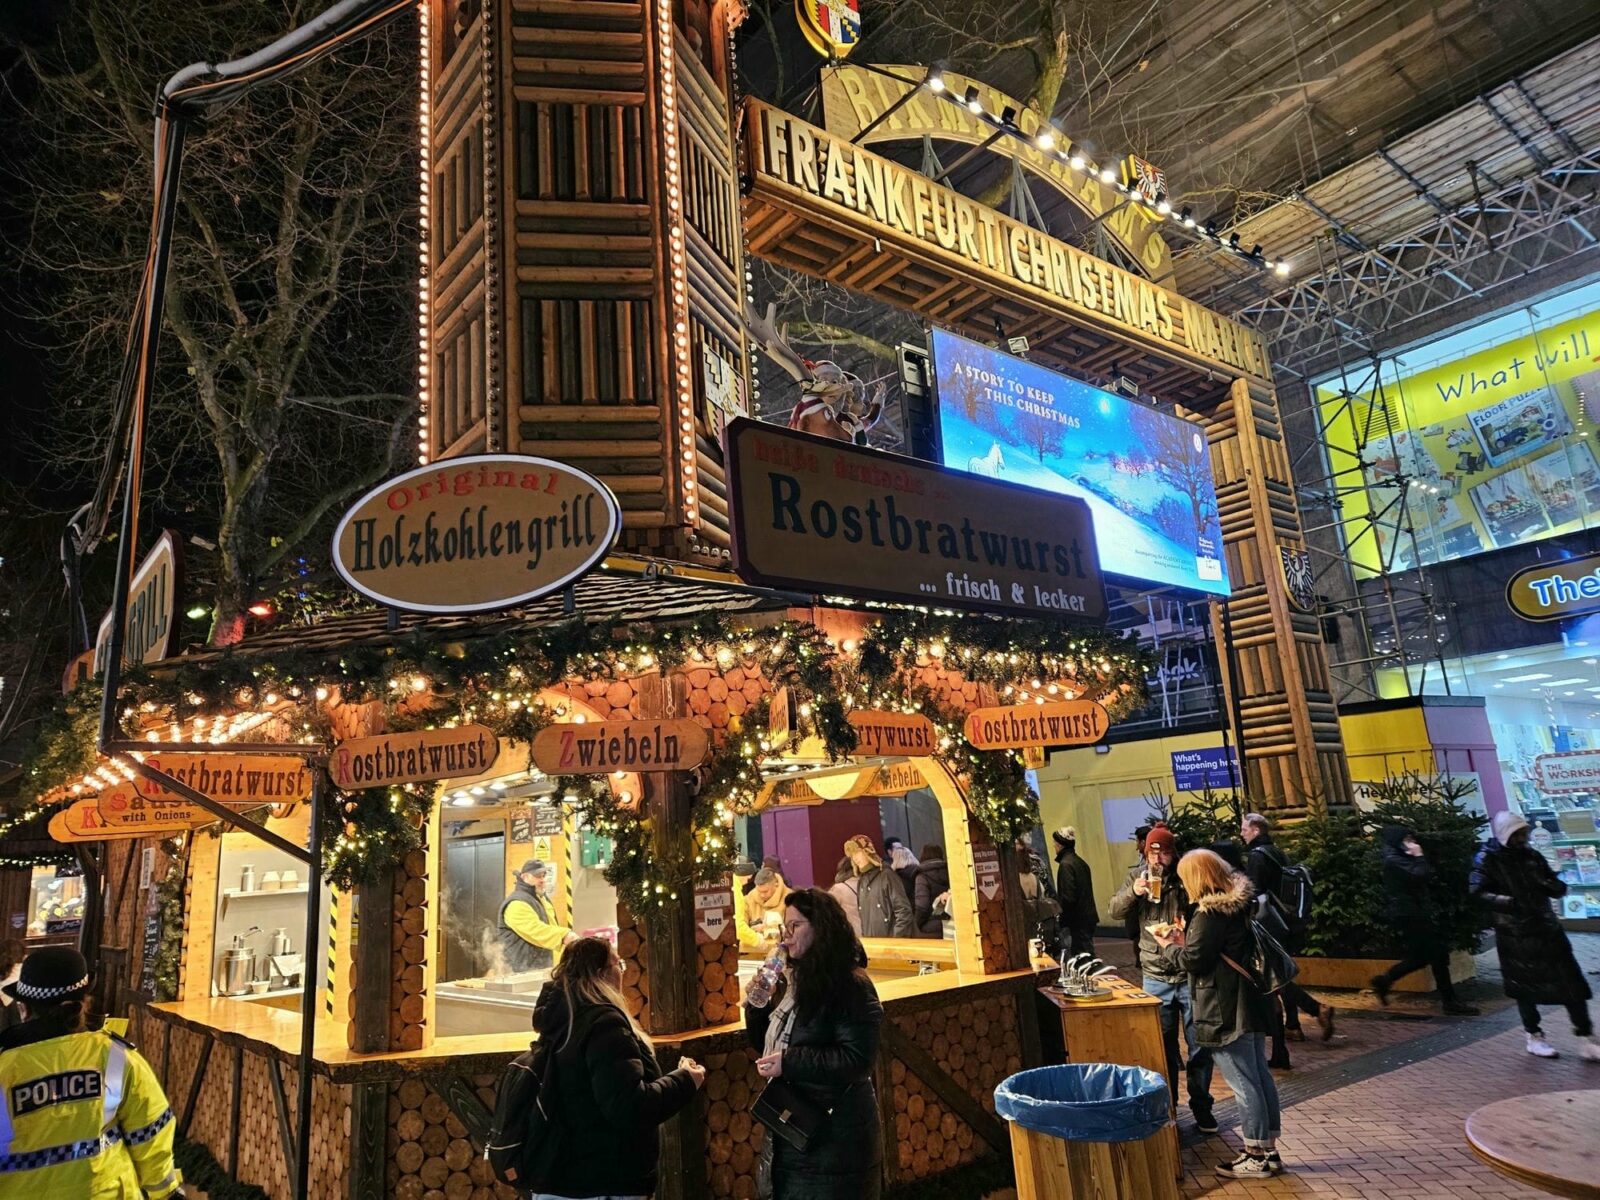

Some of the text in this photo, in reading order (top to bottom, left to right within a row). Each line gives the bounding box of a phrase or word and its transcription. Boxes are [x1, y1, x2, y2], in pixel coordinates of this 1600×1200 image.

[768, 115, 997, 266] FRANKFURT
[1010, 226, 1173, 341] CHRISTMAS
[954, 362, 1055, 405] A STORY TO KEEP
[1436, 330, 1590, 402] What will
[984, 387, 1081, 429] THIS CHRISTMAS
[387, 466, 563, 510] Original
[352, 493, 596, 572] Holzkohlengrill
[768, 473, 1087, 579] Rostbratwurst
[946, 572, 1001, 601] frisch
[1011, 585, 1025, 603] &
[1034, 585, 1086, 612] lecker
[559, 726, 680, 768] Zwiebeln
[858, 721, 931, 755] rrywurst
[971, 711, 1101, 745] Rostbratwurst
[143, 758, 306, 797] Rostbratwurst
[337, 733, 486, 785] Rostbratwurst
[707, 918, 722, 927] here
[14, 1073, 99, 1112] POLICE
